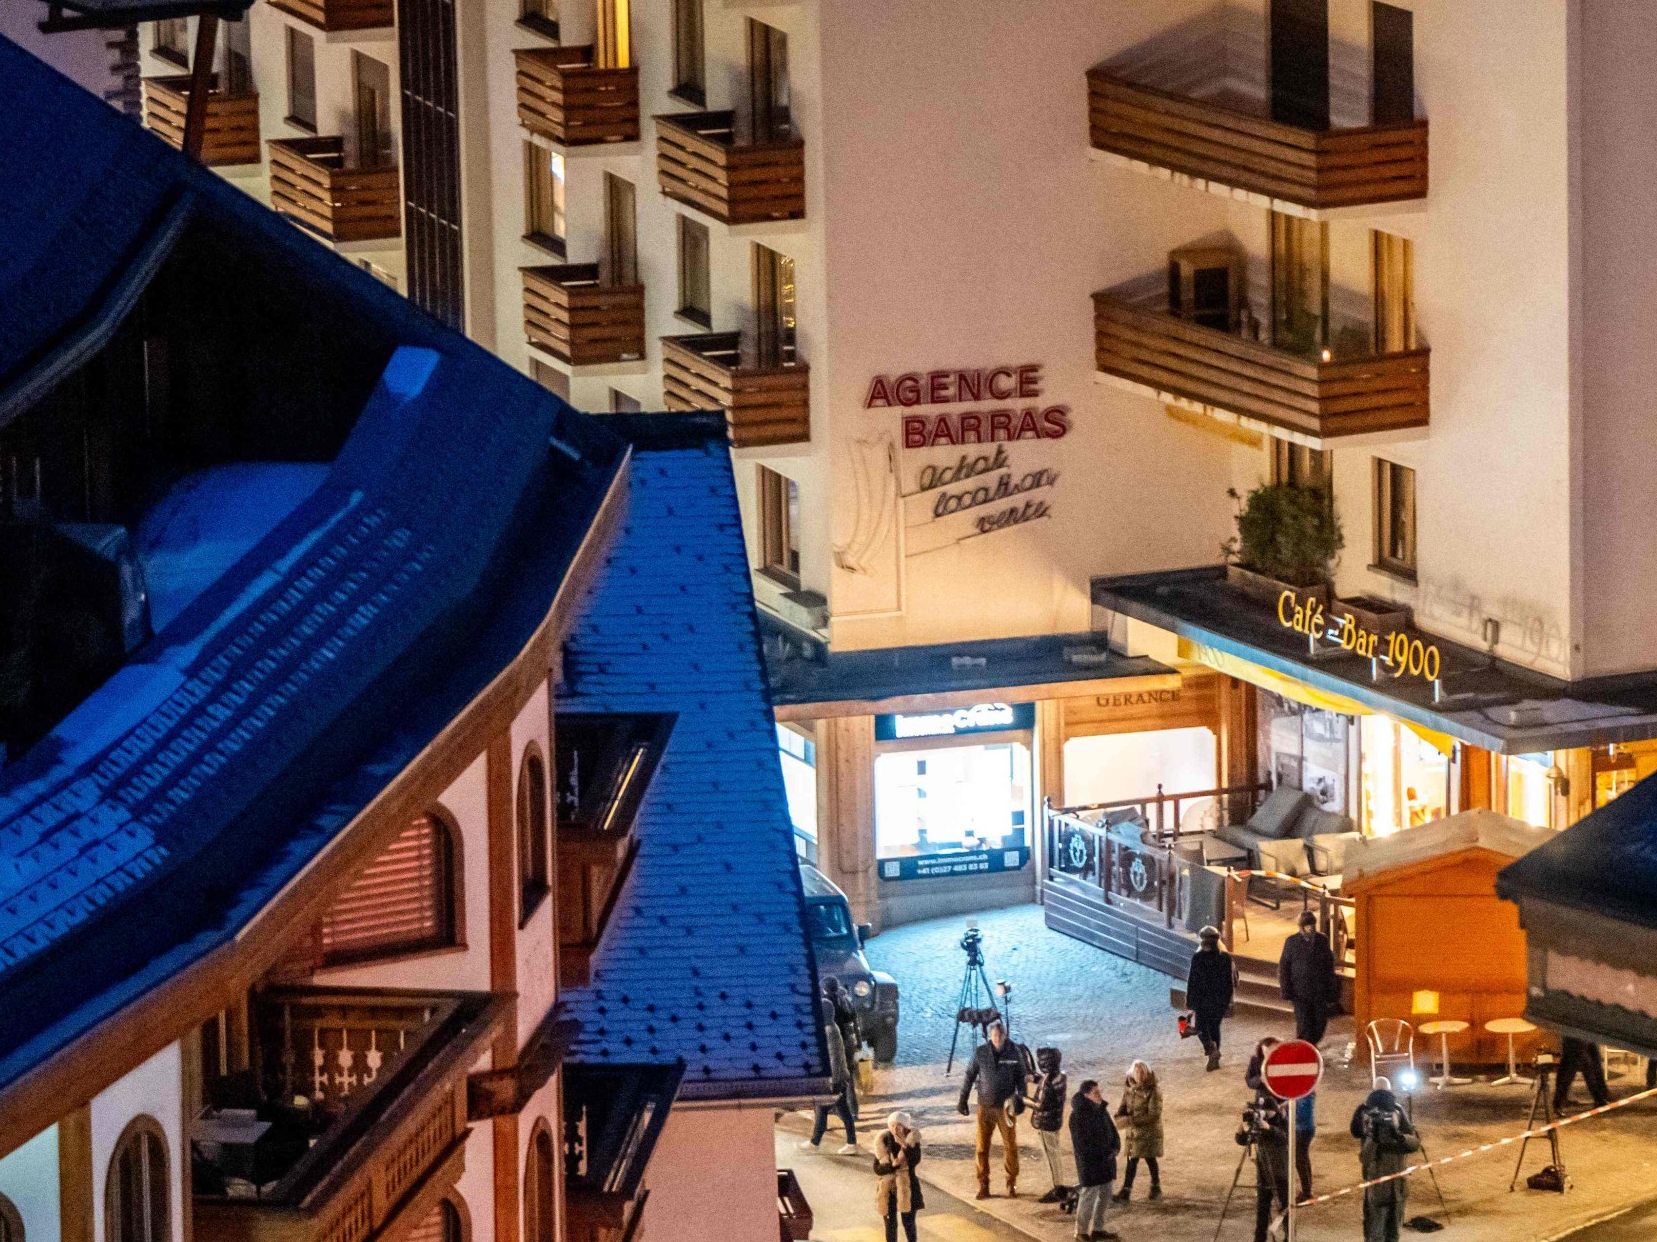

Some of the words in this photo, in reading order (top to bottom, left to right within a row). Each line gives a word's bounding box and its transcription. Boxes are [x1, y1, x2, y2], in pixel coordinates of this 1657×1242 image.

[865, 364, 1043, 409] AGENCE
[903, 404, 1072, 449] BARRAS
[919, 443, 1008, 492] achat
[934, 468, 1059, 519] location
[976, 500, 1050, 534] vente
[1385, 631, 1441, 682] 1900
